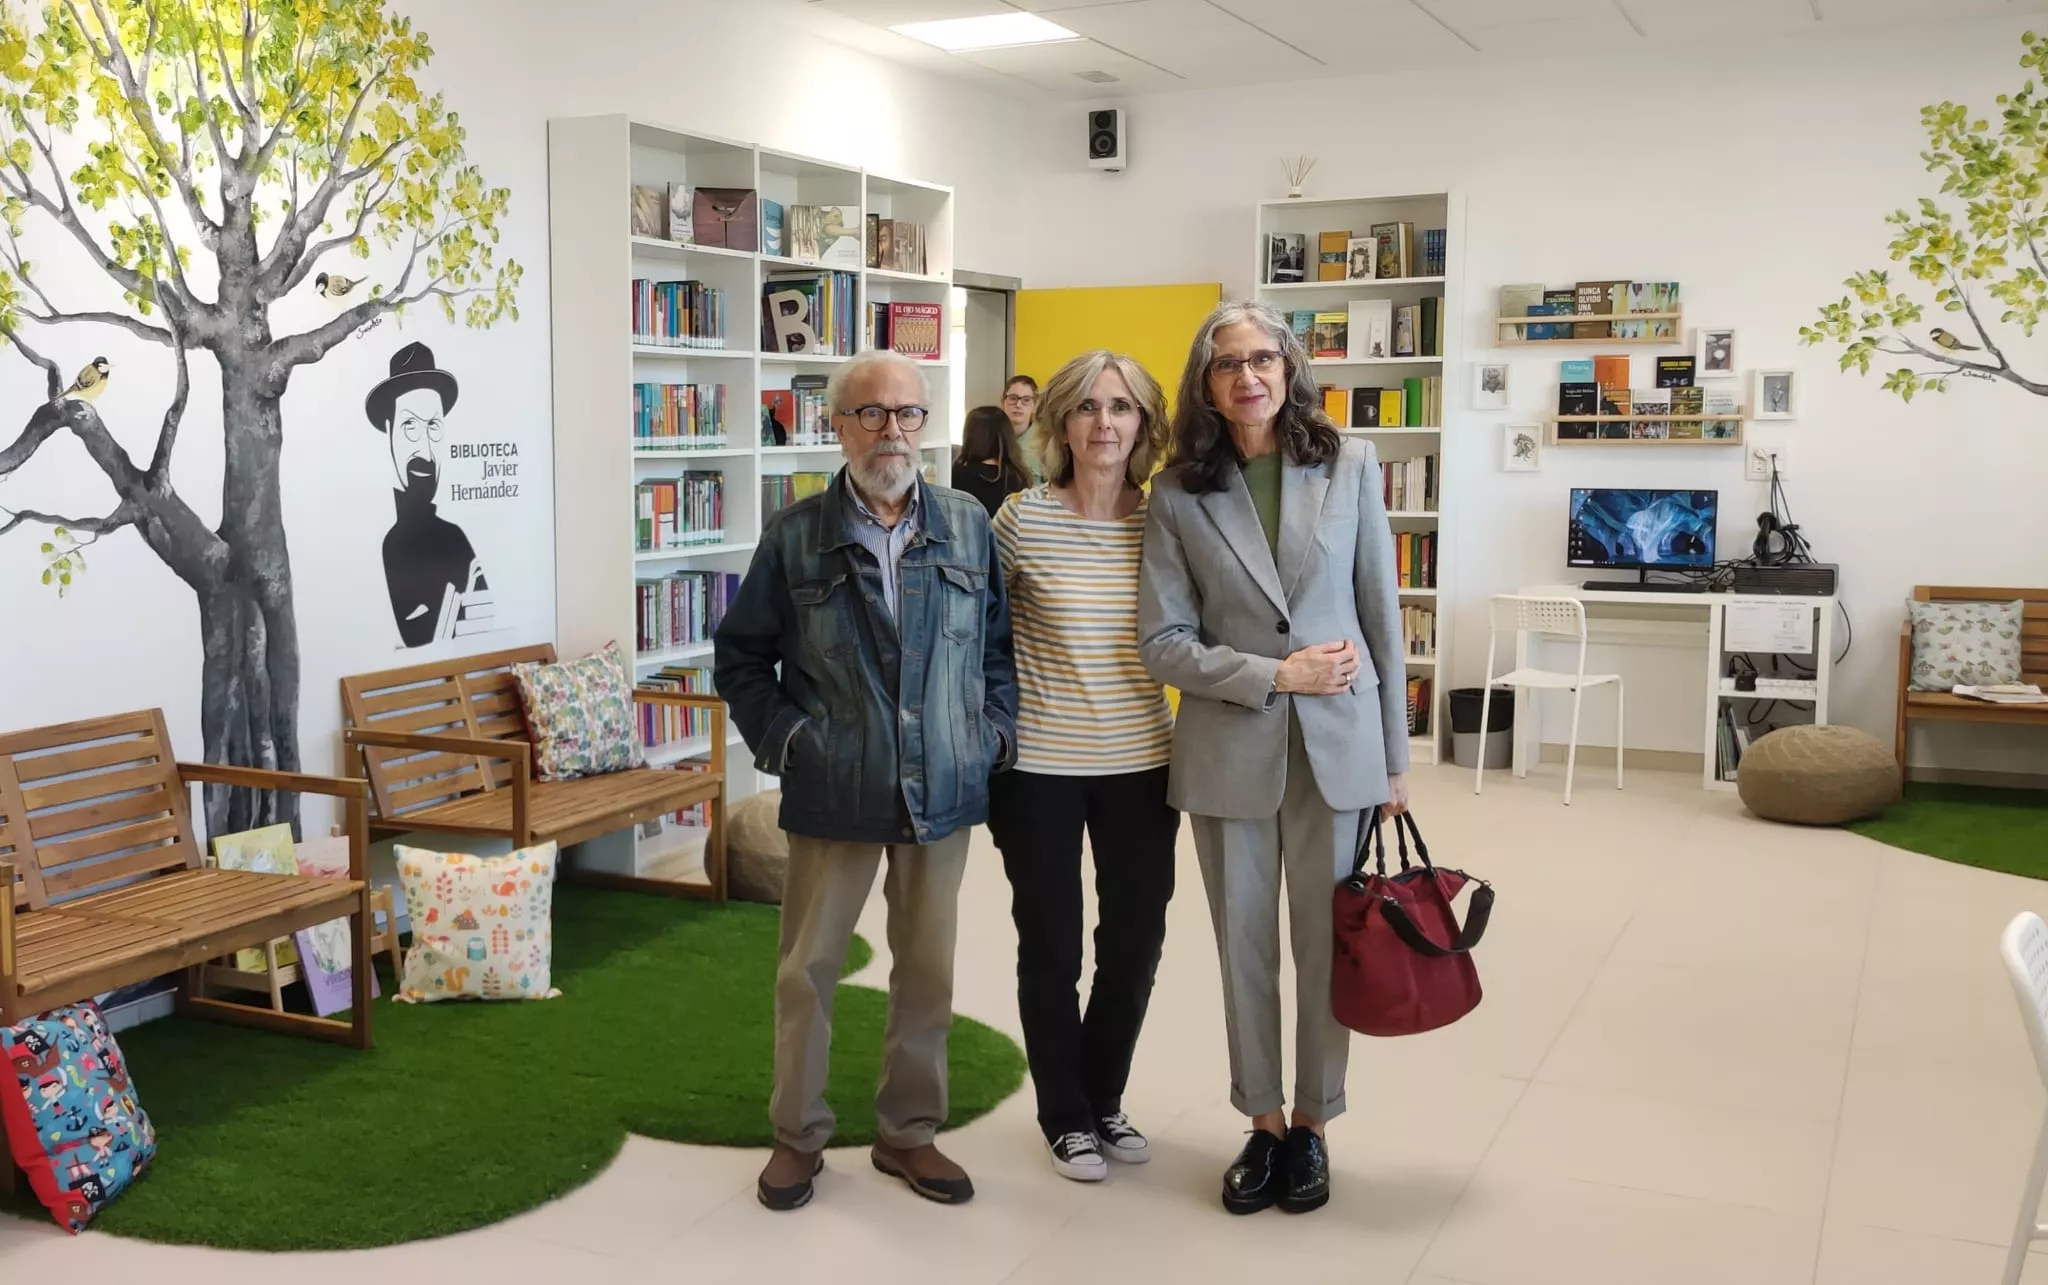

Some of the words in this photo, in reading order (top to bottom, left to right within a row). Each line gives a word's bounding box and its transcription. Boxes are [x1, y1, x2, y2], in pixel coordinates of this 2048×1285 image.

[1578, 287, 1601, 295] NUNCA
[1578, 295, 1602, 303] OLVIDO
[895, 305, 902, 313] EL
[1578, 303, 1592, 311] UNA
[769, 289, 816, 354] B
[450, 443, 518, 458] BIBLIOTECA
[481, 459, 518, 480] Javier
[451, 480, 519, 501] Hernández
